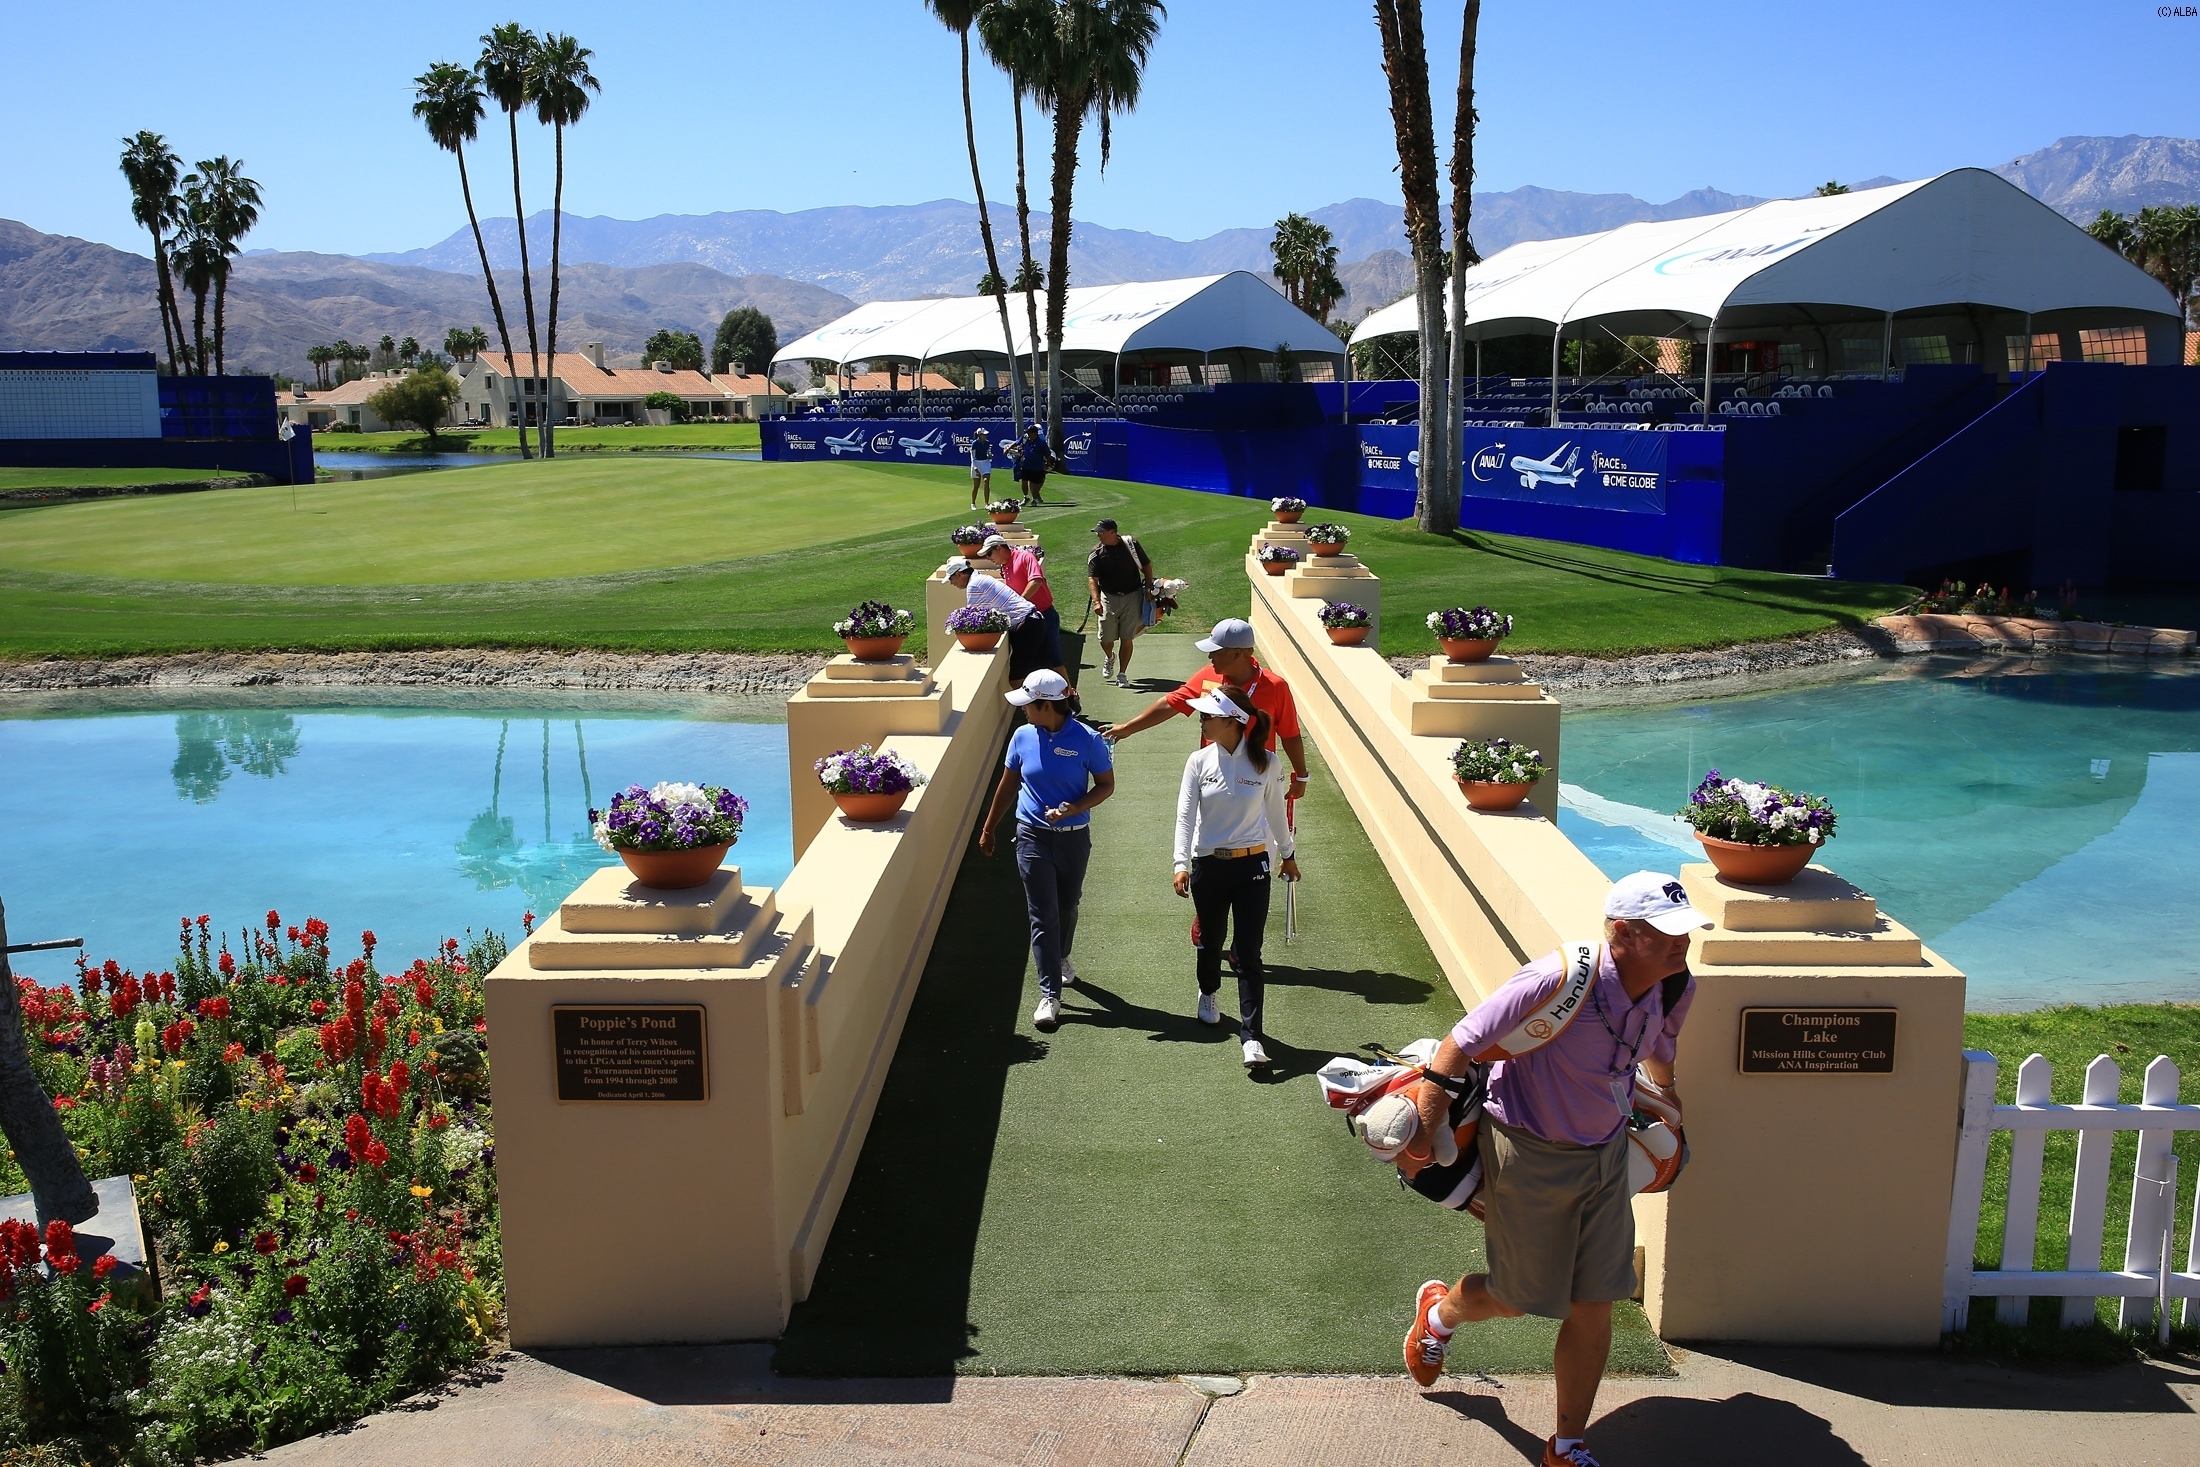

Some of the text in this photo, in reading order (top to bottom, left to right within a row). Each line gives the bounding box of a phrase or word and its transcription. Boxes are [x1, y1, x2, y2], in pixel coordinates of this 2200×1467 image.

[1068, 440, 1082, 450] ANA
[1365, 446, 1378, 454] RACE
[1373, 459, 1400, 470] CME GLOBE
[1479, 455, 1496, 468] ANA
[1599, 457, 1620, 469] RACE
[1610, 476, 1656, 489] CME GLOBE
[1550, 946, 1590, 1020] Hanwha
[579, 1016, 676, 1031] Poppie's Pond
[1782, 1013, 1860, 1028] Champions
[626, 1038, 648, 1047] Terry
[1802, 1031, 1838, 1043] Lake
[573, 1048, 618, 1056] recognition
[1752, 1050, 1886, 1060] Mission Hills Country Club
[1778, 1061, 1859, 1070] ANA Inspiration
[625, 1077, 657, 1086] through
